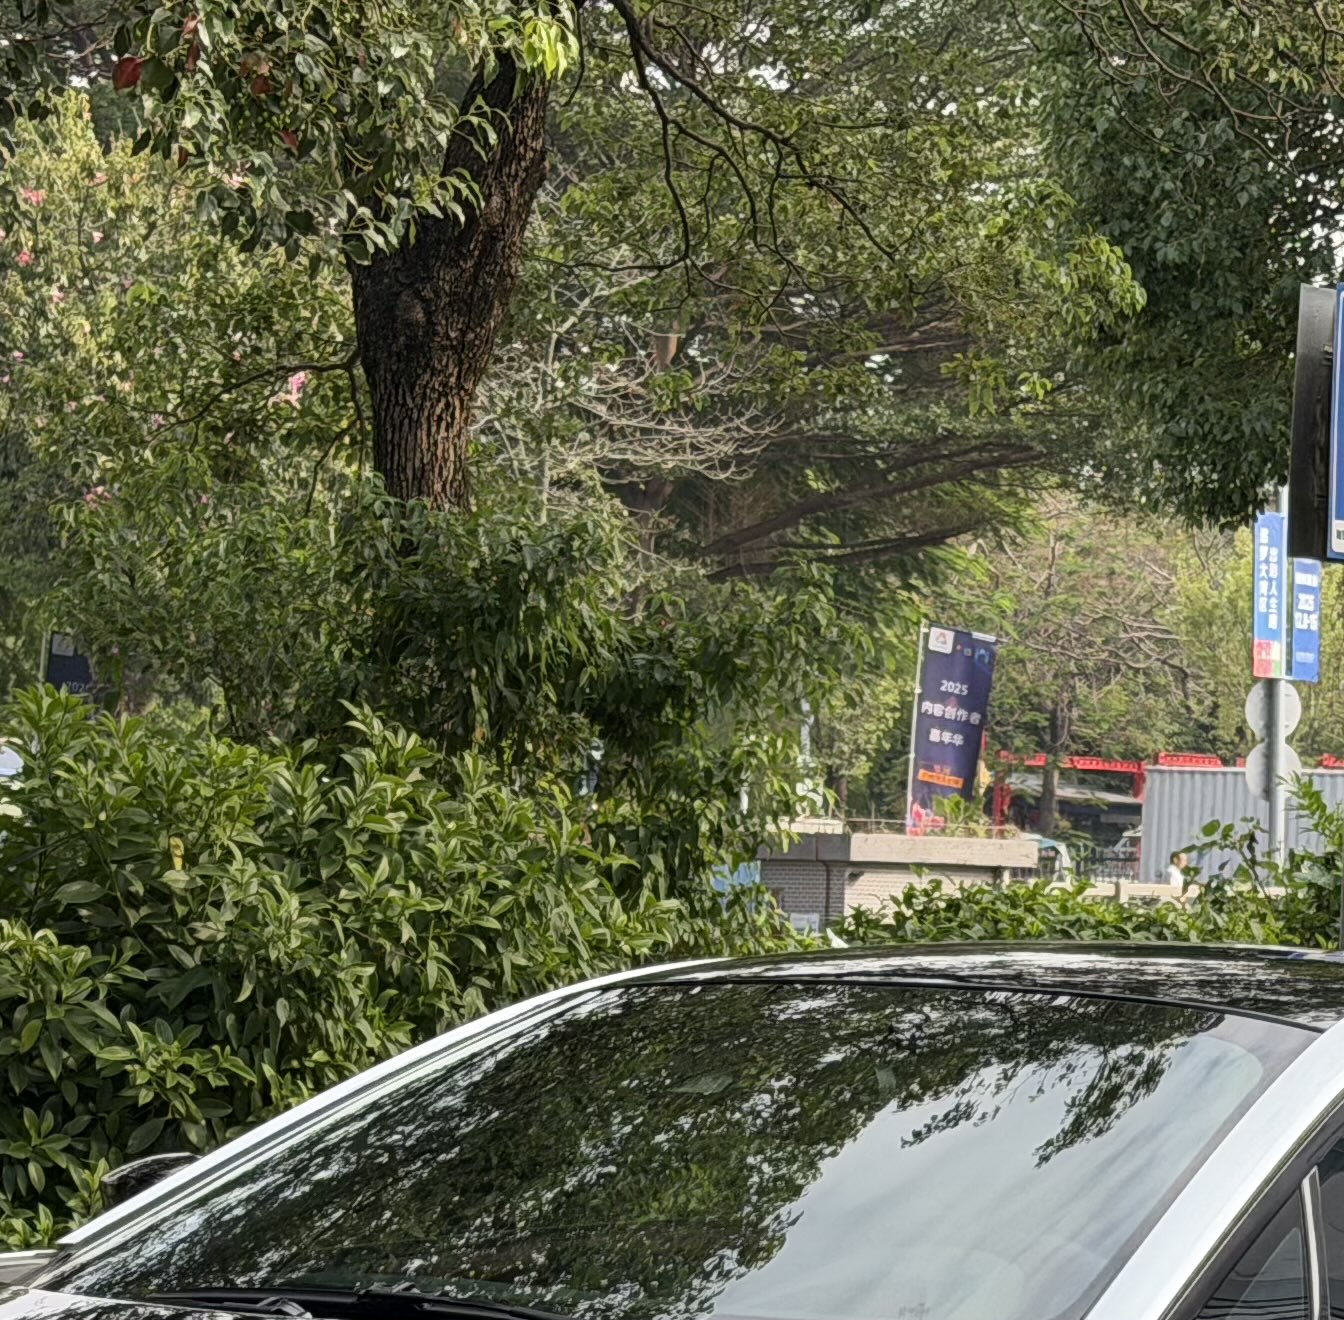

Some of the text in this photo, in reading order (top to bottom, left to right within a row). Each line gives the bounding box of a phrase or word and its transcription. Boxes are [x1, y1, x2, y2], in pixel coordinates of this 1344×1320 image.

[939, 679, 969, 696] 2025
[921, 700, 982, 726] 内容创作者
[928, 727, 965, 747] 嘉年华
